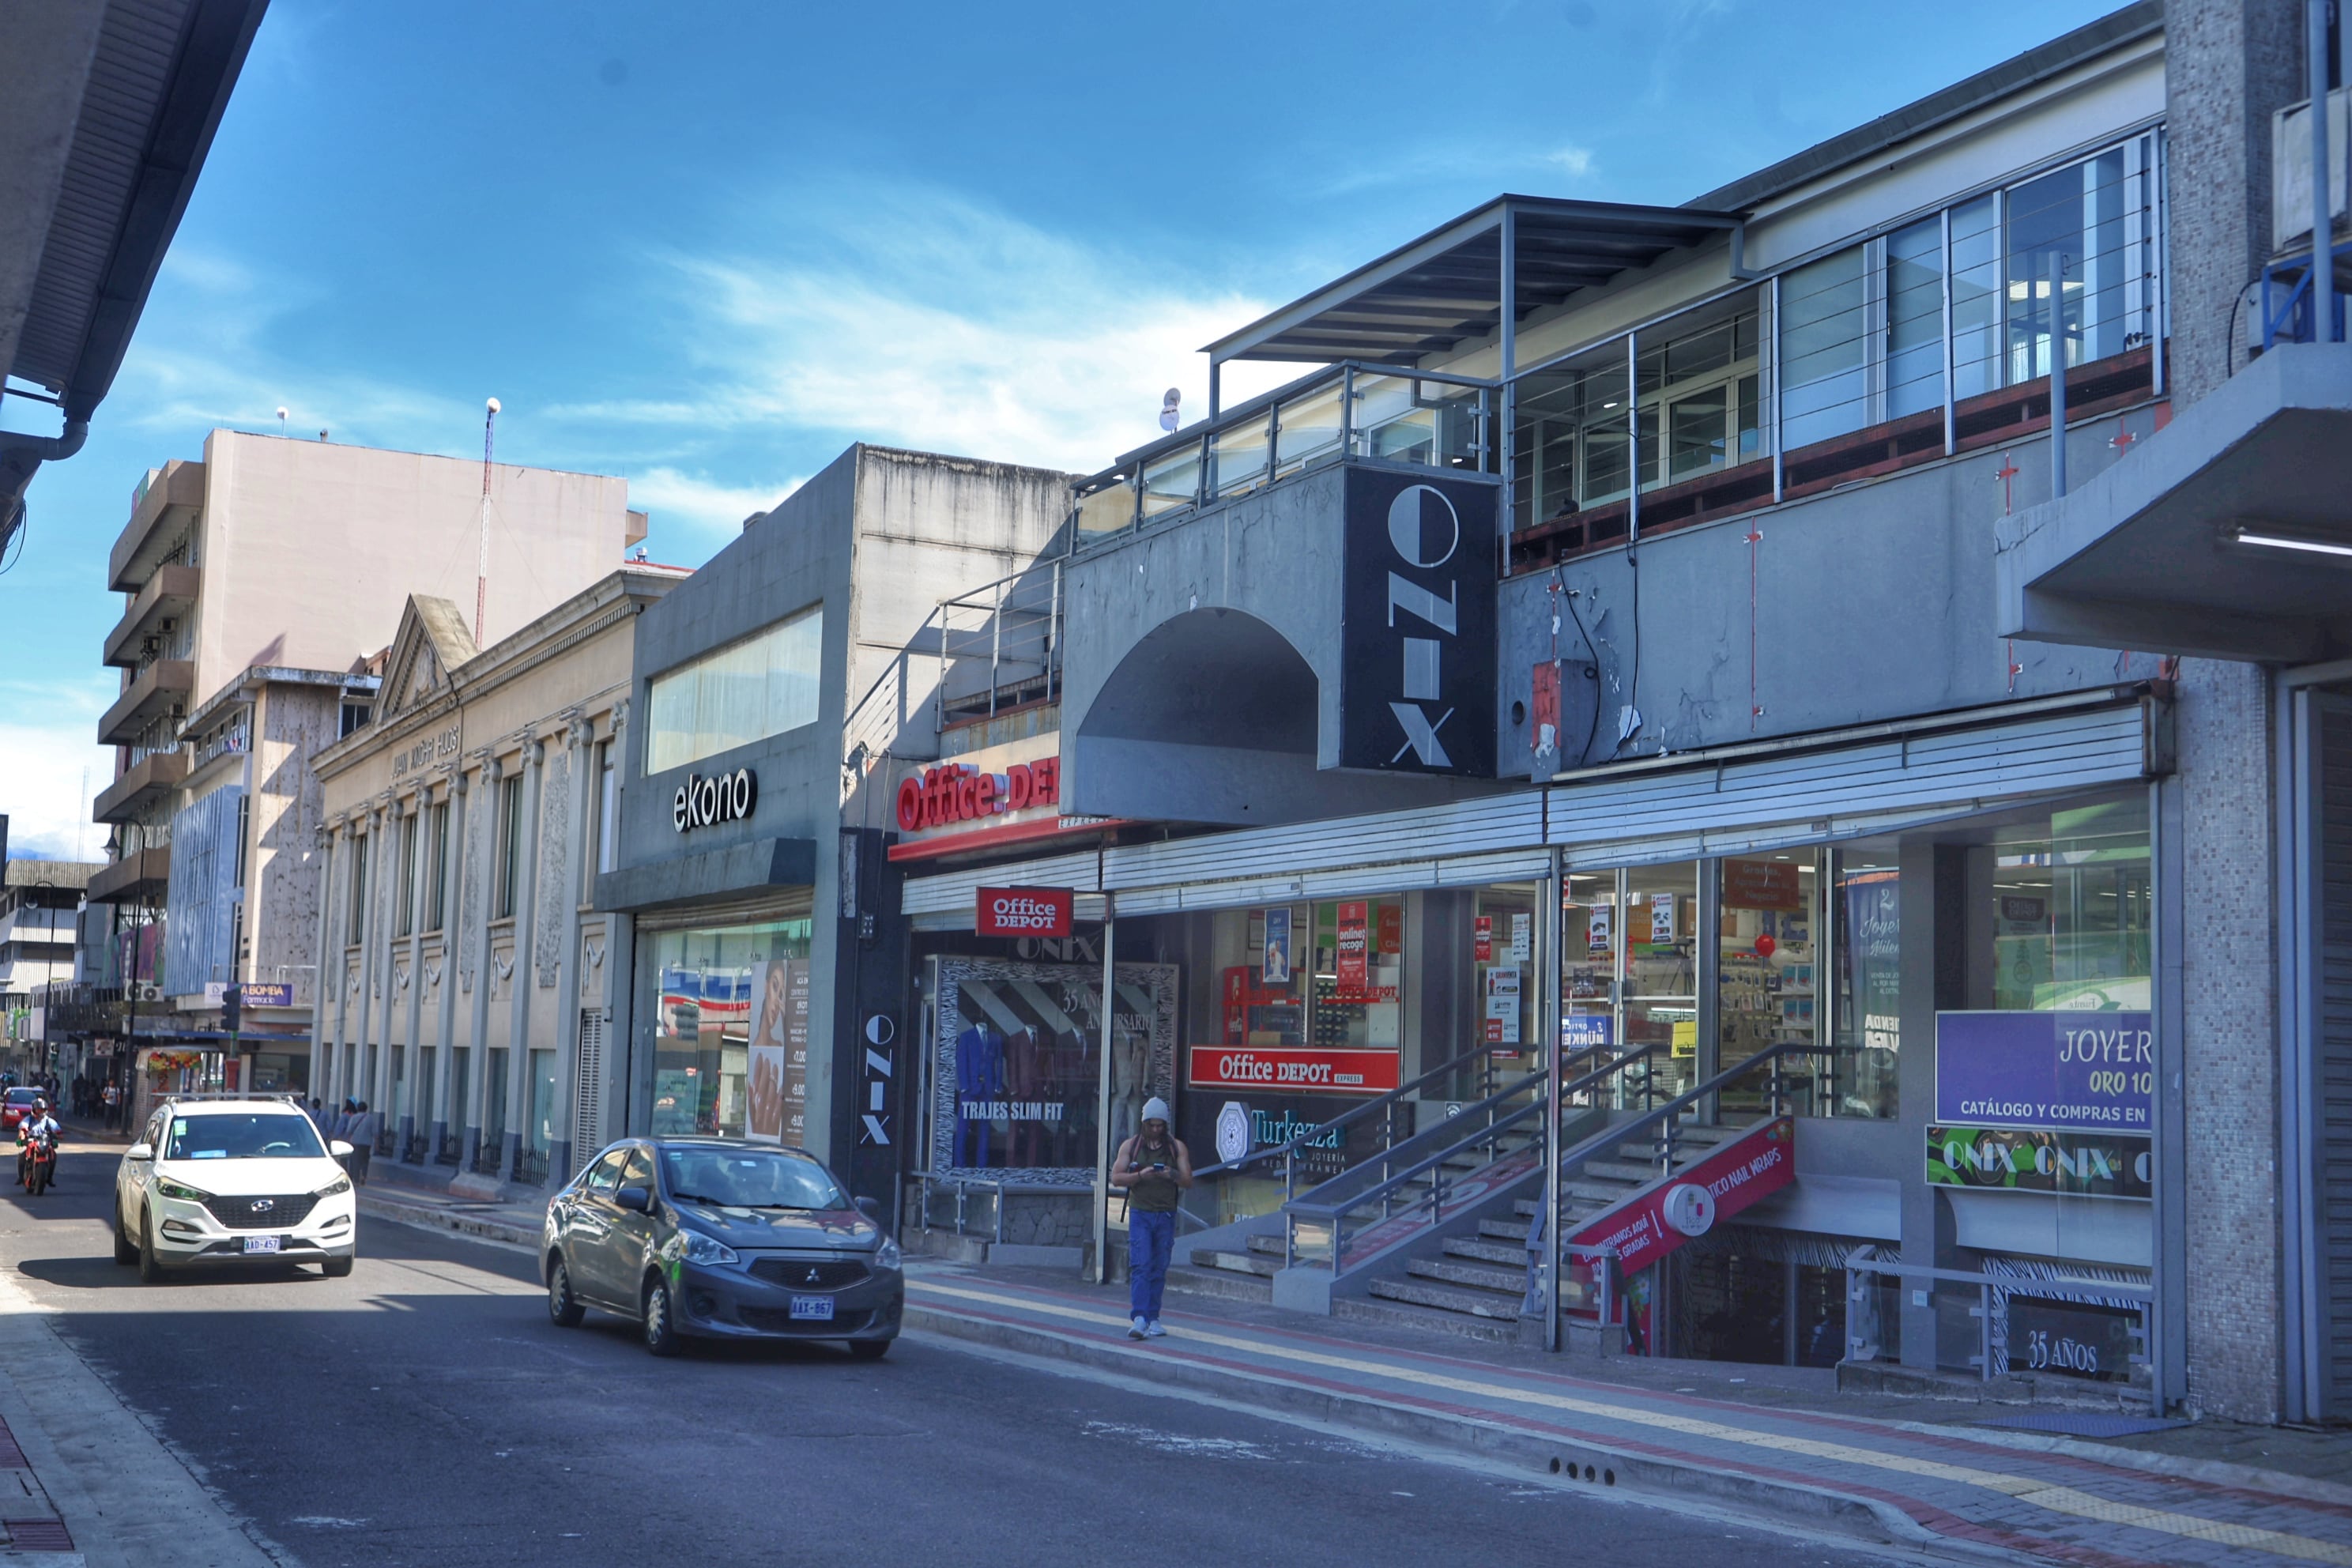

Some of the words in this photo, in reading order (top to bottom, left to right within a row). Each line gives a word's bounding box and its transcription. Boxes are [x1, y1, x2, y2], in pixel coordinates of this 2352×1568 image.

[1388, 484, 1460, 767] ONIX
[673, 767, 755, 833] ekono
[896, 762, 997, 832] Office
[993, 898, 1056, 916] Office
[995, 914, 1055, 929] DEPOT
[1340, 940, 1364, 952] recoge
[249, 985, 284, 996] BOMBA
[1063, 988, 1078, 1013] 35
[860, 1015, 895, 1144] ONIX
[1219, 1054, 1273, 1080] Office
[1277, 1062, 1332, 1083] DEPOT
[2090, 1070, 2126, 1097] ORO
[962, 1101, 1008, 1120] TRAJES
[1010, 1101, 1042, 1121] SLIM
[1044, 1102, 1065, 1121] FIT
[1960, 1098, 2033, 1117] CATÁLOGO
[2037, 1104, 2046, 1118] Y
[2050, 1105, 2121, 1121] COMPRAS
[2125, 1108, 2146, 1122] EN
[1311, 1152, 1345, 1163] JOYERÍA
[1943, 1140, 2017, 1174] ONIX
[2034, 1145, 2115, 1180] ONIX
[1708, 1178, 1729, 1200] TICO
[1728, 1168, 1751, 1188] NAIL
[1750, 1148, 1782, 1177] WRAPS
[1631, 1214, 1649, 1235] AQUÍ
[1623, 1234, 1650, 1257] GRADAS
[2029, 1330, 2048, 1369] 35
[2051, 1337, 2098, 1373] AÑOS
